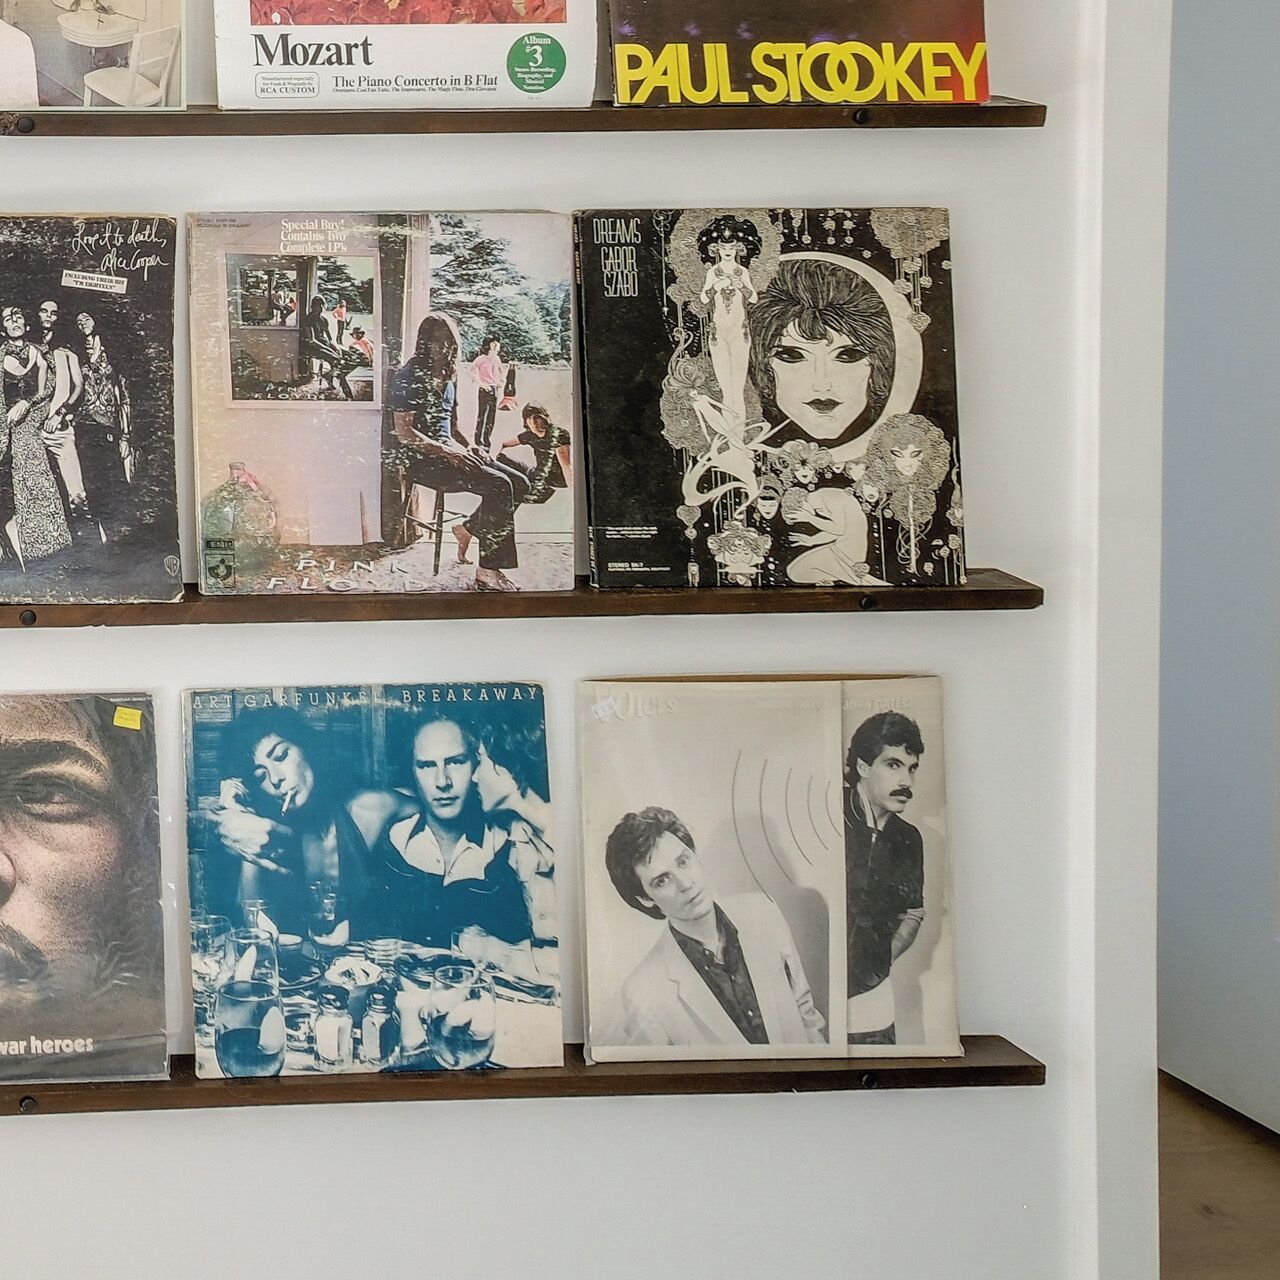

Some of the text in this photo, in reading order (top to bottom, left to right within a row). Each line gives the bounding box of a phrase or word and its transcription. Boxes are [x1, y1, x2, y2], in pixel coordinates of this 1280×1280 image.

[250, 33, 374, 67] Mozart
[522, 36, 551, 45] Album
[332, 74, 498, 87] The Piano Concerto in B Flat
[614, 42, 987, 104] PAUL STOOKEY
[260, 86, 315, 94] RCA CUSTOM
[281, 219, 345, 232] Special Buy!
[593, 218, 642, 244] DREAMS
[72, 219, 100, 255] Love
[280, 230, 325, 241] Contains
[280, 241, 325, 255] Complete
[601, 246, 638, 272] GABOR
[604, 271, 638, 297] SZABO
[297, 559, 408, 574] PINK
[193, 687, 538, 709] ART GARFUNKEL BREAKAWAY
[30, 1036, 94, 1055] heroes
